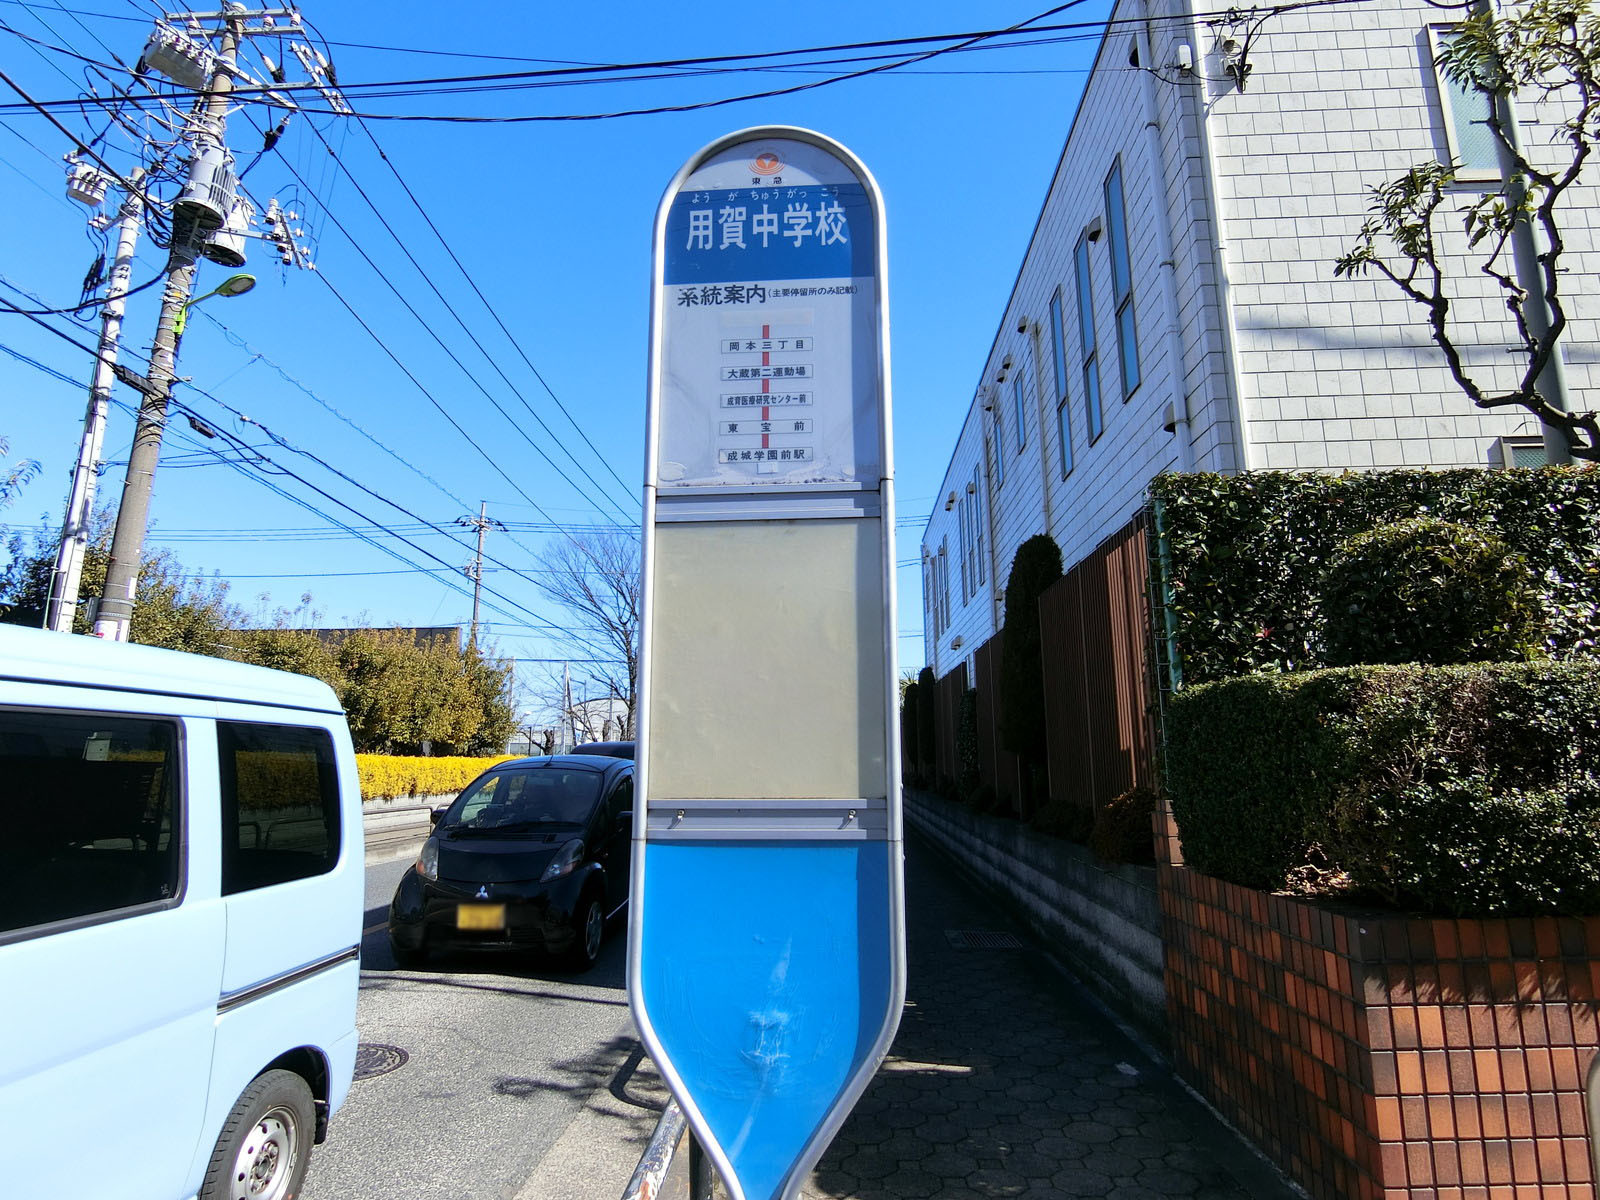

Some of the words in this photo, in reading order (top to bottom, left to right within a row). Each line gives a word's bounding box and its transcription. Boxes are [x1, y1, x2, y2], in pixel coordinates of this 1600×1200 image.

[686, 200, 849, 251] 用賀中学校
[677, 284, 766, 308] 系統案内
[729, 339, 804, 352] 岡本三丁目
[727, 366, 806, 379] 大蔵第二運動場
[727, 393, 807, 406] 成育医療研究センター前
[728, 421, 805, 433] 東宝前
[727, 449, 805, 461] 成城学園前駅
